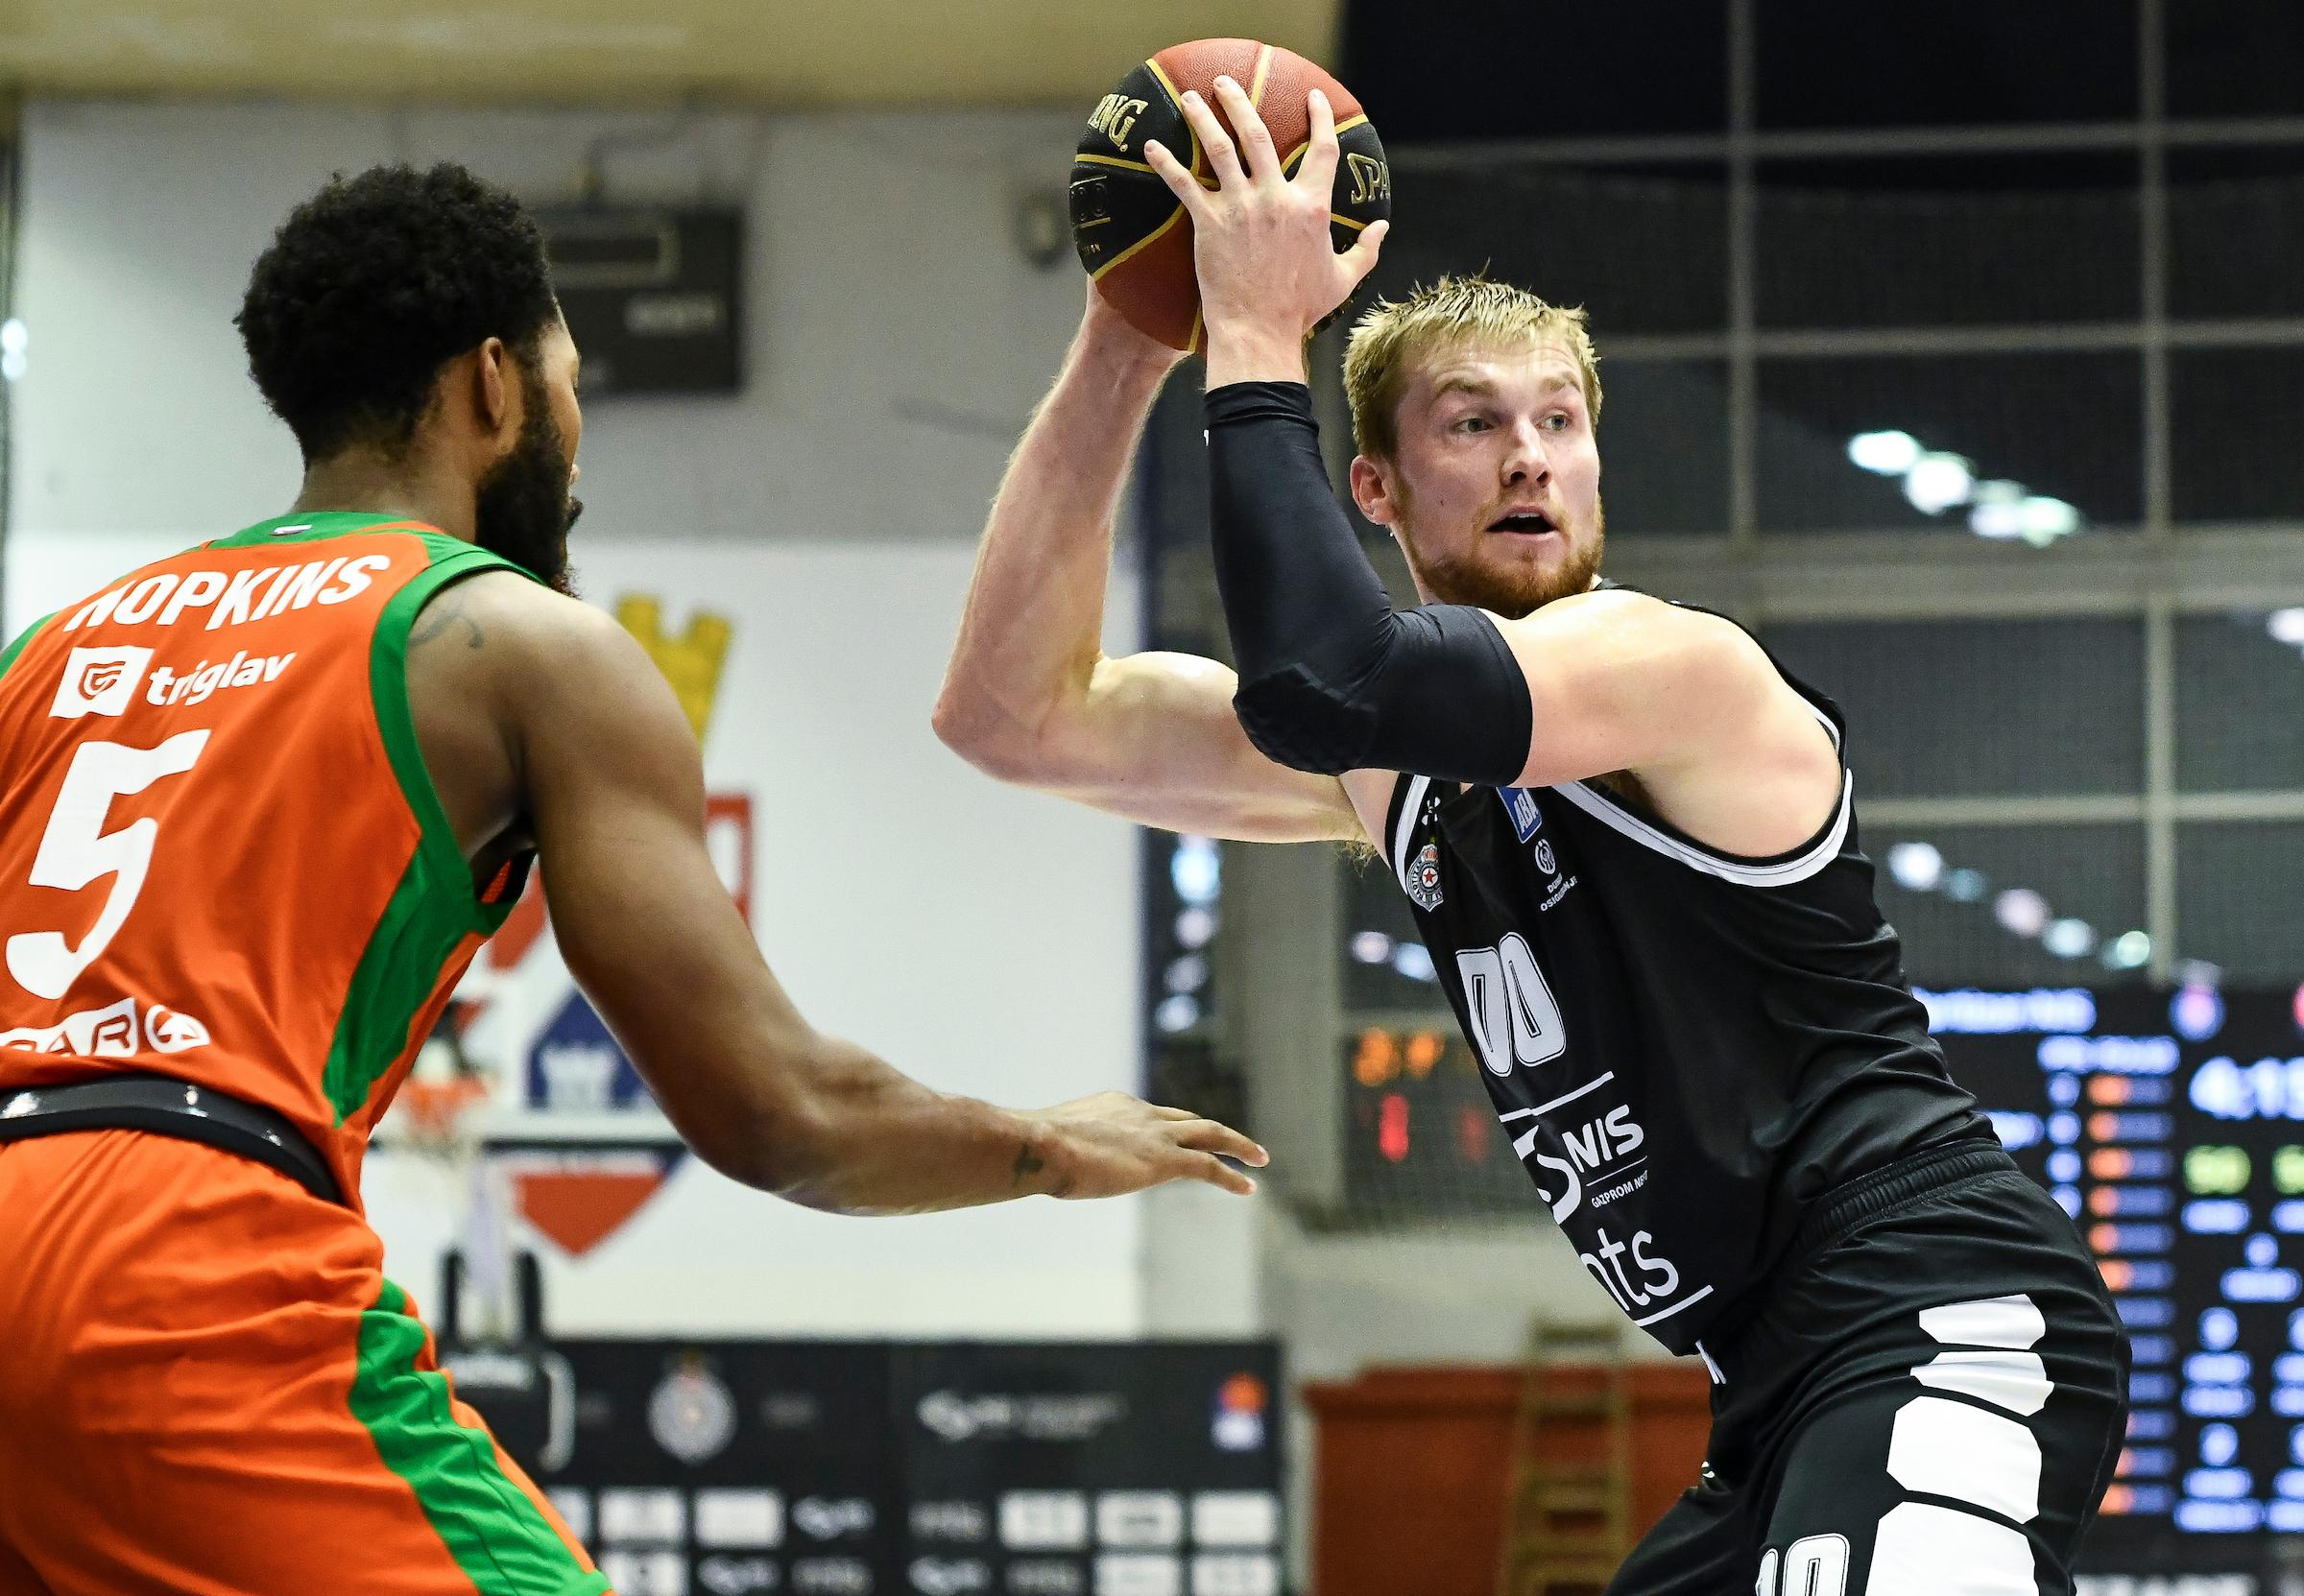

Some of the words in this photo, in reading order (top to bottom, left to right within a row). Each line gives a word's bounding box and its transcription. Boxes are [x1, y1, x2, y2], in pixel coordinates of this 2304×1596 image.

[146, 651, 298, 706] triglav
[7, 729, 210, 999] 5
[1562, 1105, 1644, 1173] NIS
[1591, 1181, 1634, 1208] GAZPROM
